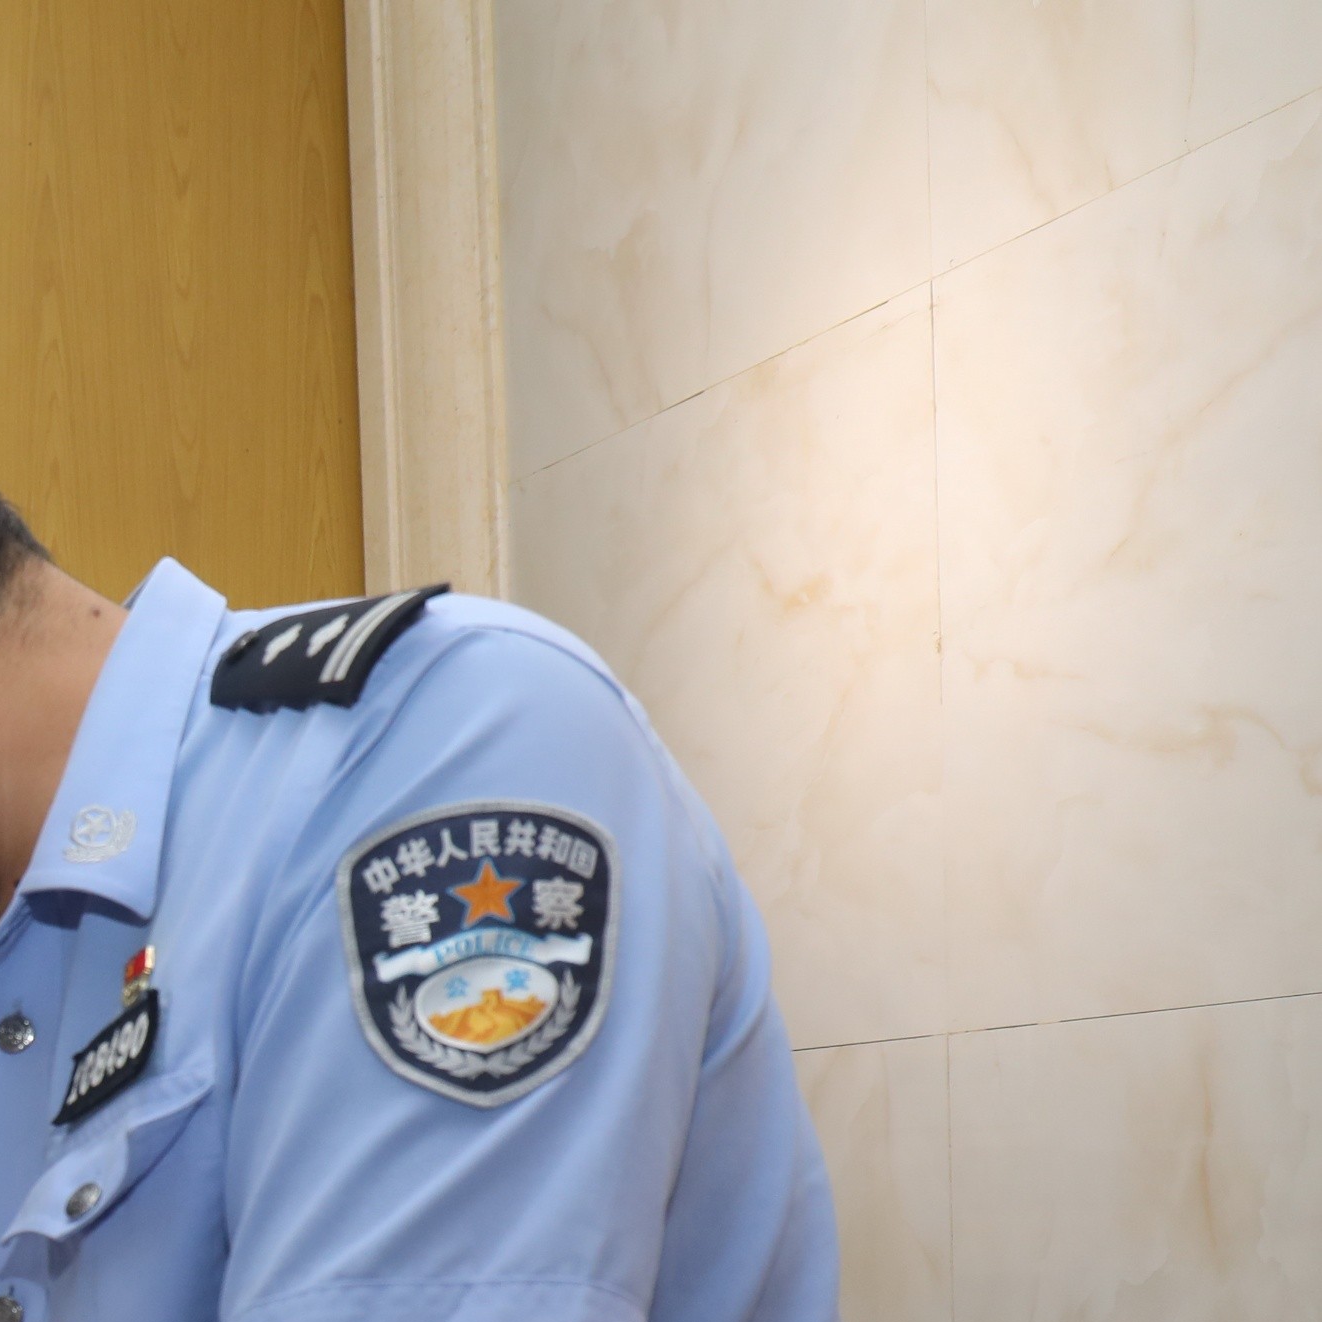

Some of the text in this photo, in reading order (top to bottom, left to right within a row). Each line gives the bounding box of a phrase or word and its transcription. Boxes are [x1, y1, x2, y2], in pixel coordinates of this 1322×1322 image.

[362, 818, 599, 894] 中华人民共和国
[379, 875, 585, 949] 警 察
